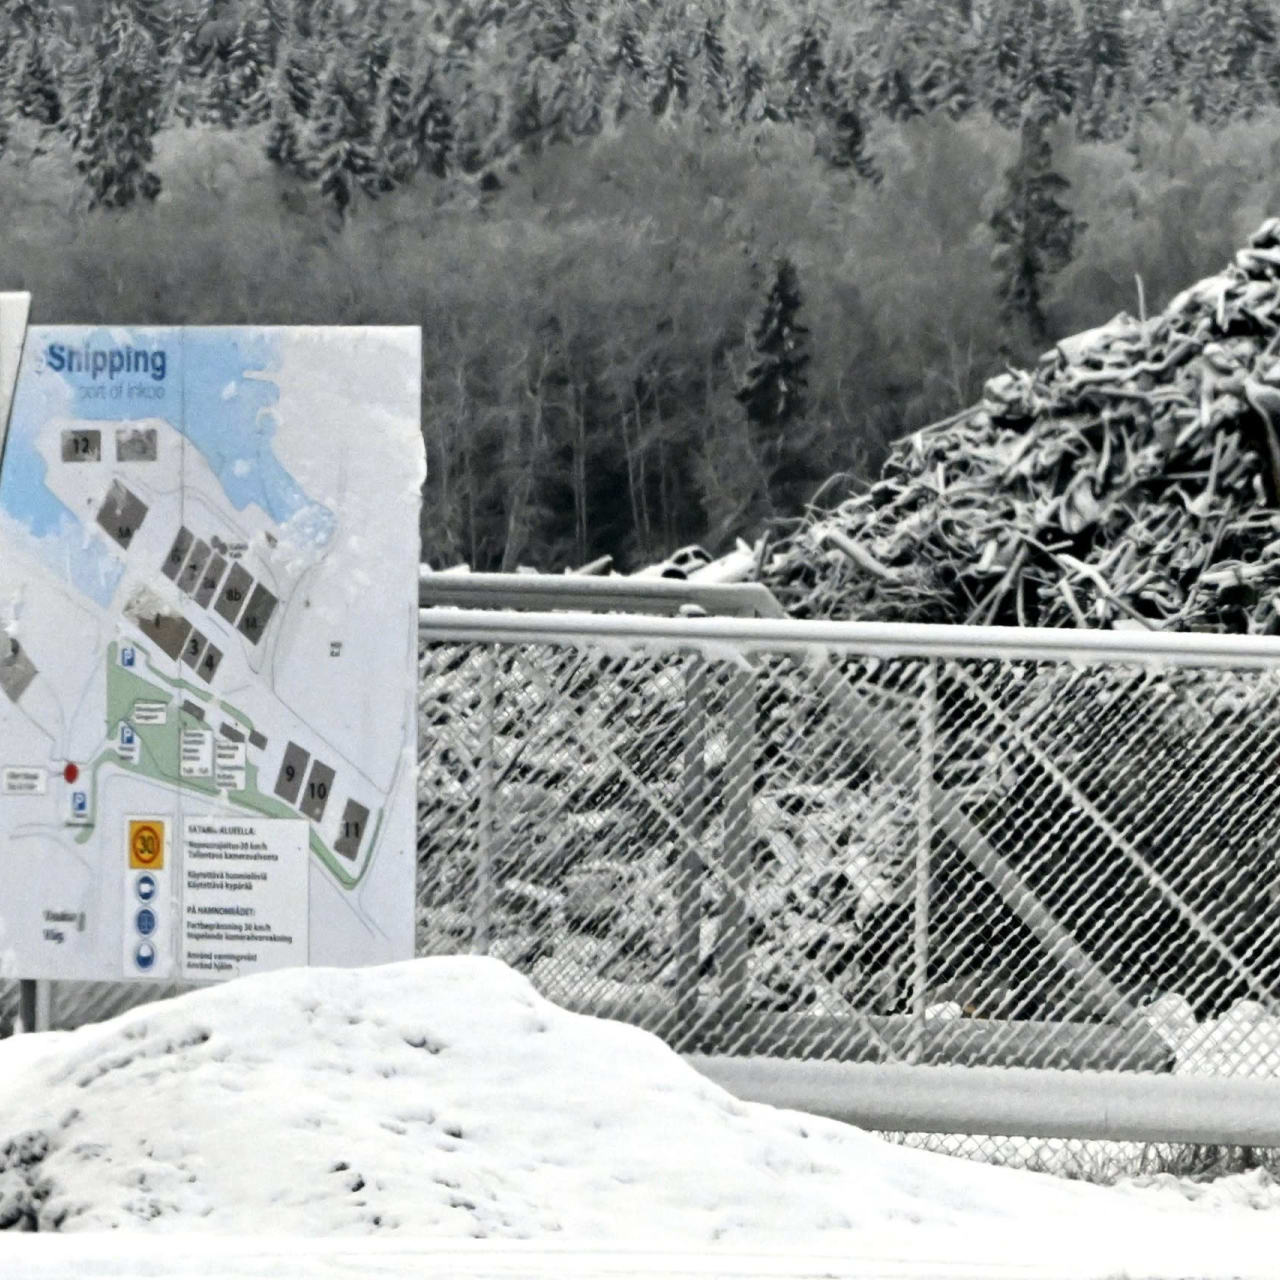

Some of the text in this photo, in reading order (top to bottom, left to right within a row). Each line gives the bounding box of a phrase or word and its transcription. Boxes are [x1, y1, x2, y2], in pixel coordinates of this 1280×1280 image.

[190, 638, 199, 656] 3
[286, 765, 295, 782] 9
[310, 783, 327, 800] 10
